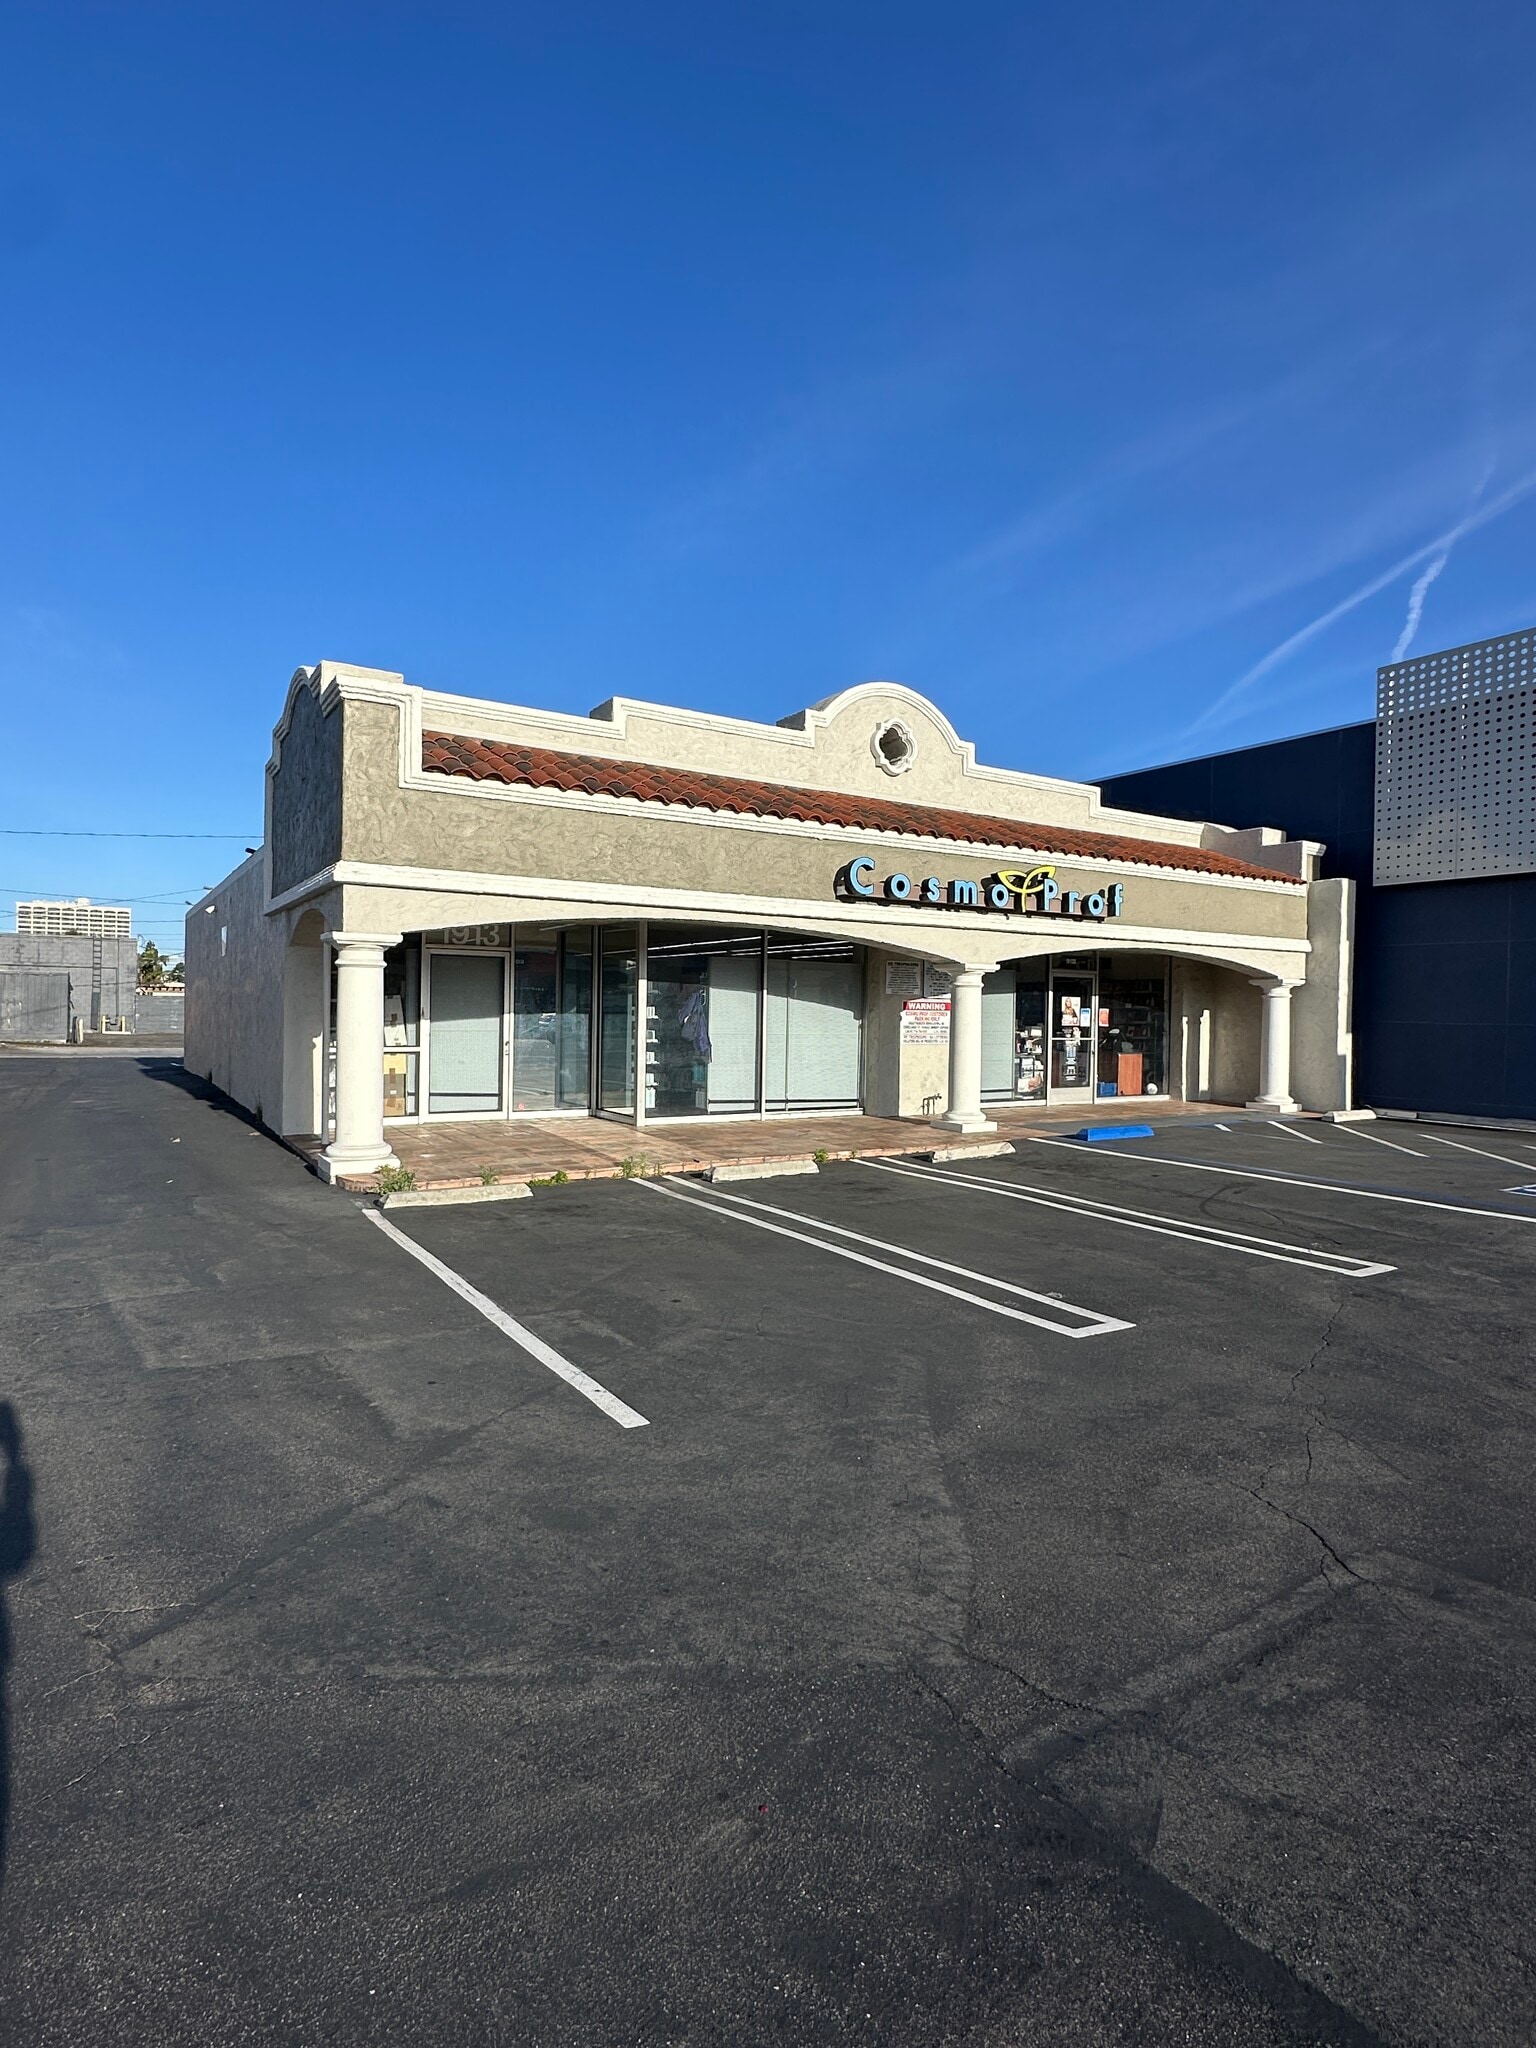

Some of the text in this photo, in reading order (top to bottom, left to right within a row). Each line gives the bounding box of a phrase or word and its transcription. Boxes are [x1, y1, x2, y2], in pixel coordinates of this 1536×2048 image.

[842, 856, 1124, 917] Cosmo Prof
[443, 925, 500, 946] 1913
[908, 1002, 946, 1011] WARNING
